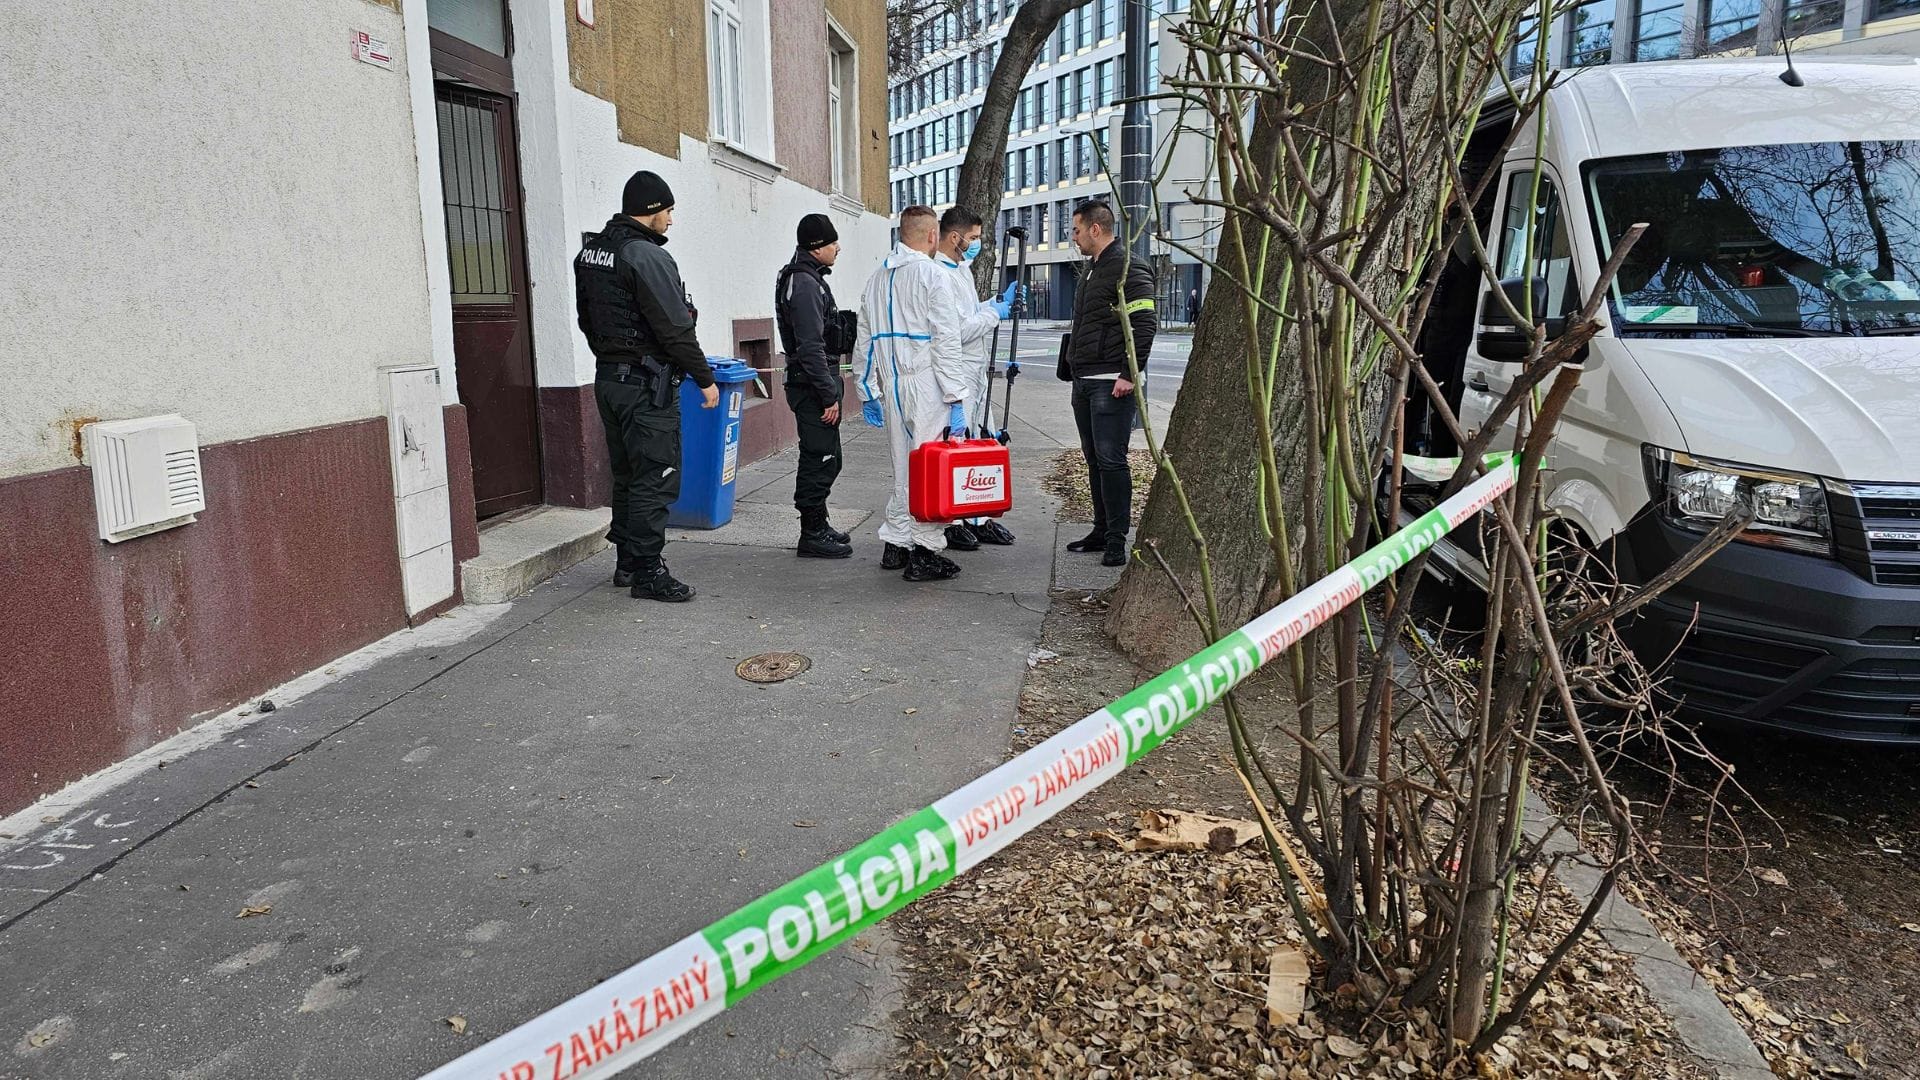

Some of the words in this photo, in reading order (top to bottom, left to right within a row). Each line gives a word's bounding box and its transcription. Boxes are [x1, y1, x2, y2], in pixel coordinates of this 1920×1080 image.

[580, 247, 615, 268] POLÍCIA
[961, 468, 998, 491] Leica
[1260, 619, 1303, 659] VSTUP
[1122, 645, 1254, 753] POLÍCIA
[958, 784, 1027, 847] VSTUP
[1028, 722, 1121, 807] ZAKÁZANÝ
[722, 828, 950, 989] POLÍCIA
[545, 955, 712, 1080] ZAKÁZANÝ
